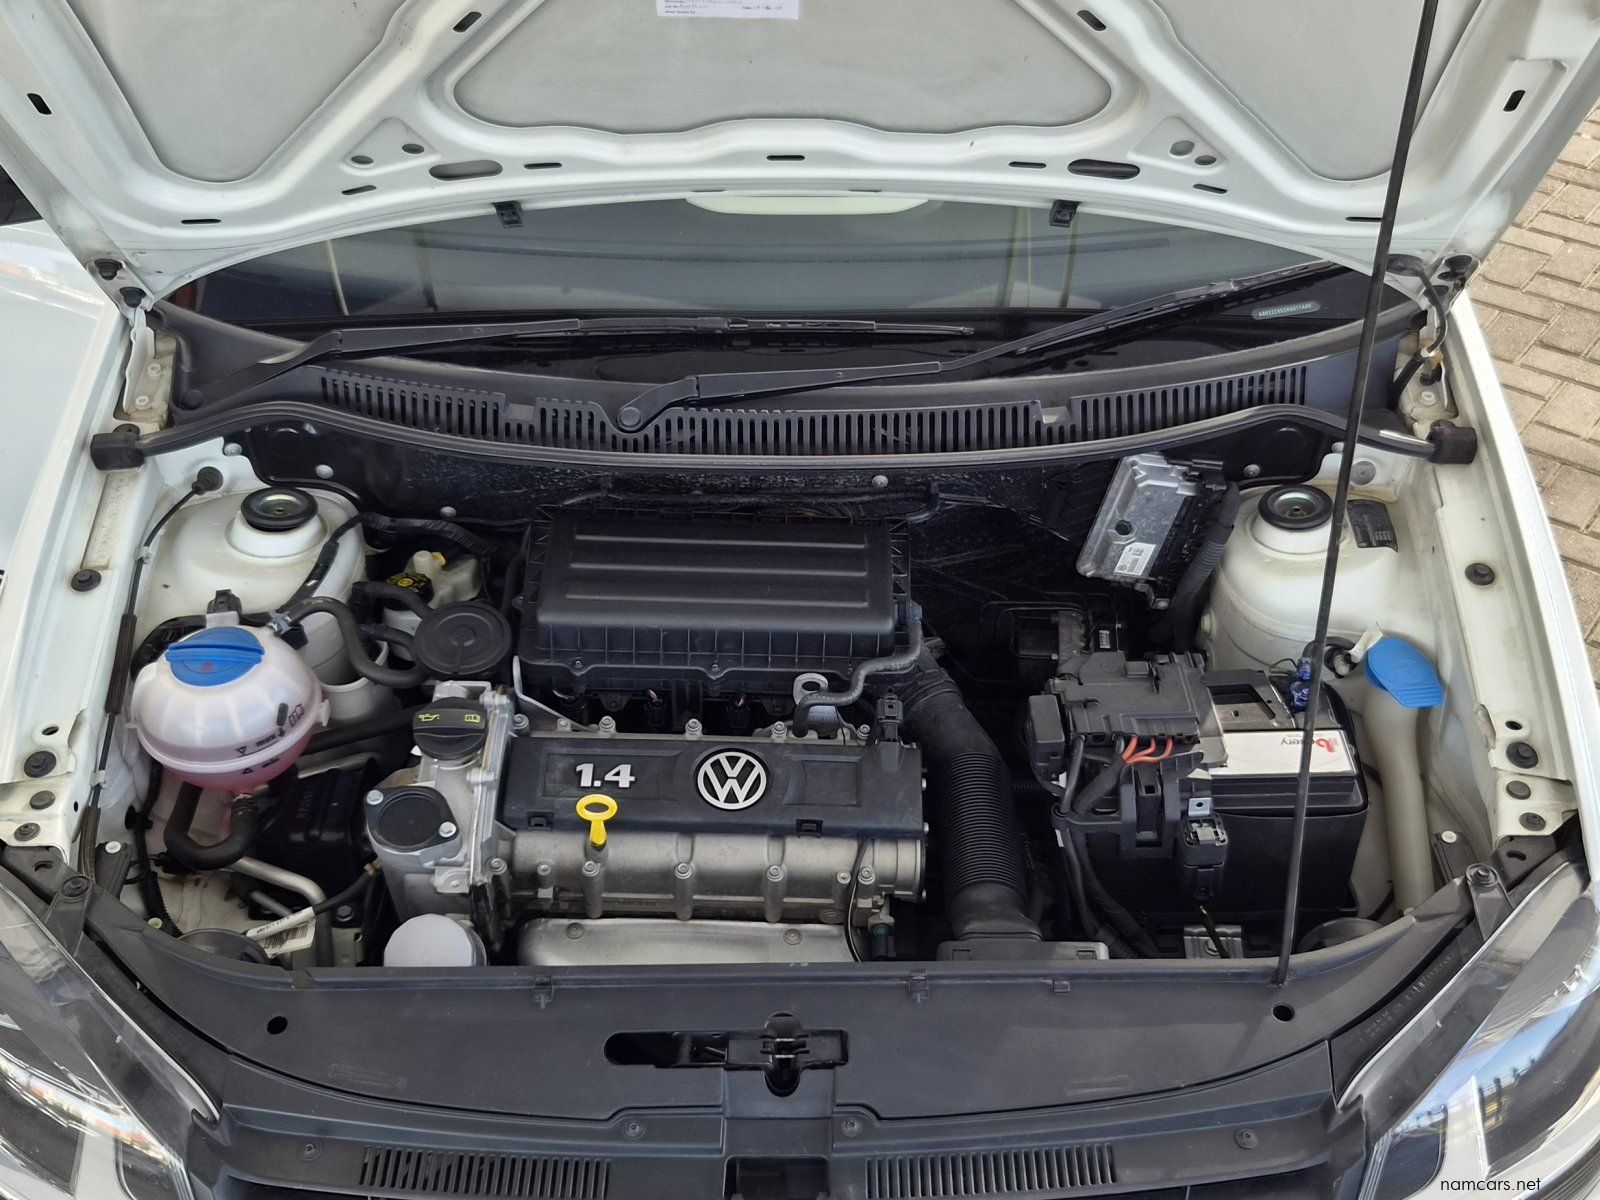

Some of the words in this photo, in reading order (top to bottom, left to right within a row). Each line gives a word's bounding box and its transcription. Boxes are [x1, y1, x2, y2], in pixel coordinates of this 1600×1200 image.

[256, 733, 277, 747] max
[576, 763, 635, 788] 1.4
[698, 752, 767, 810] VW
